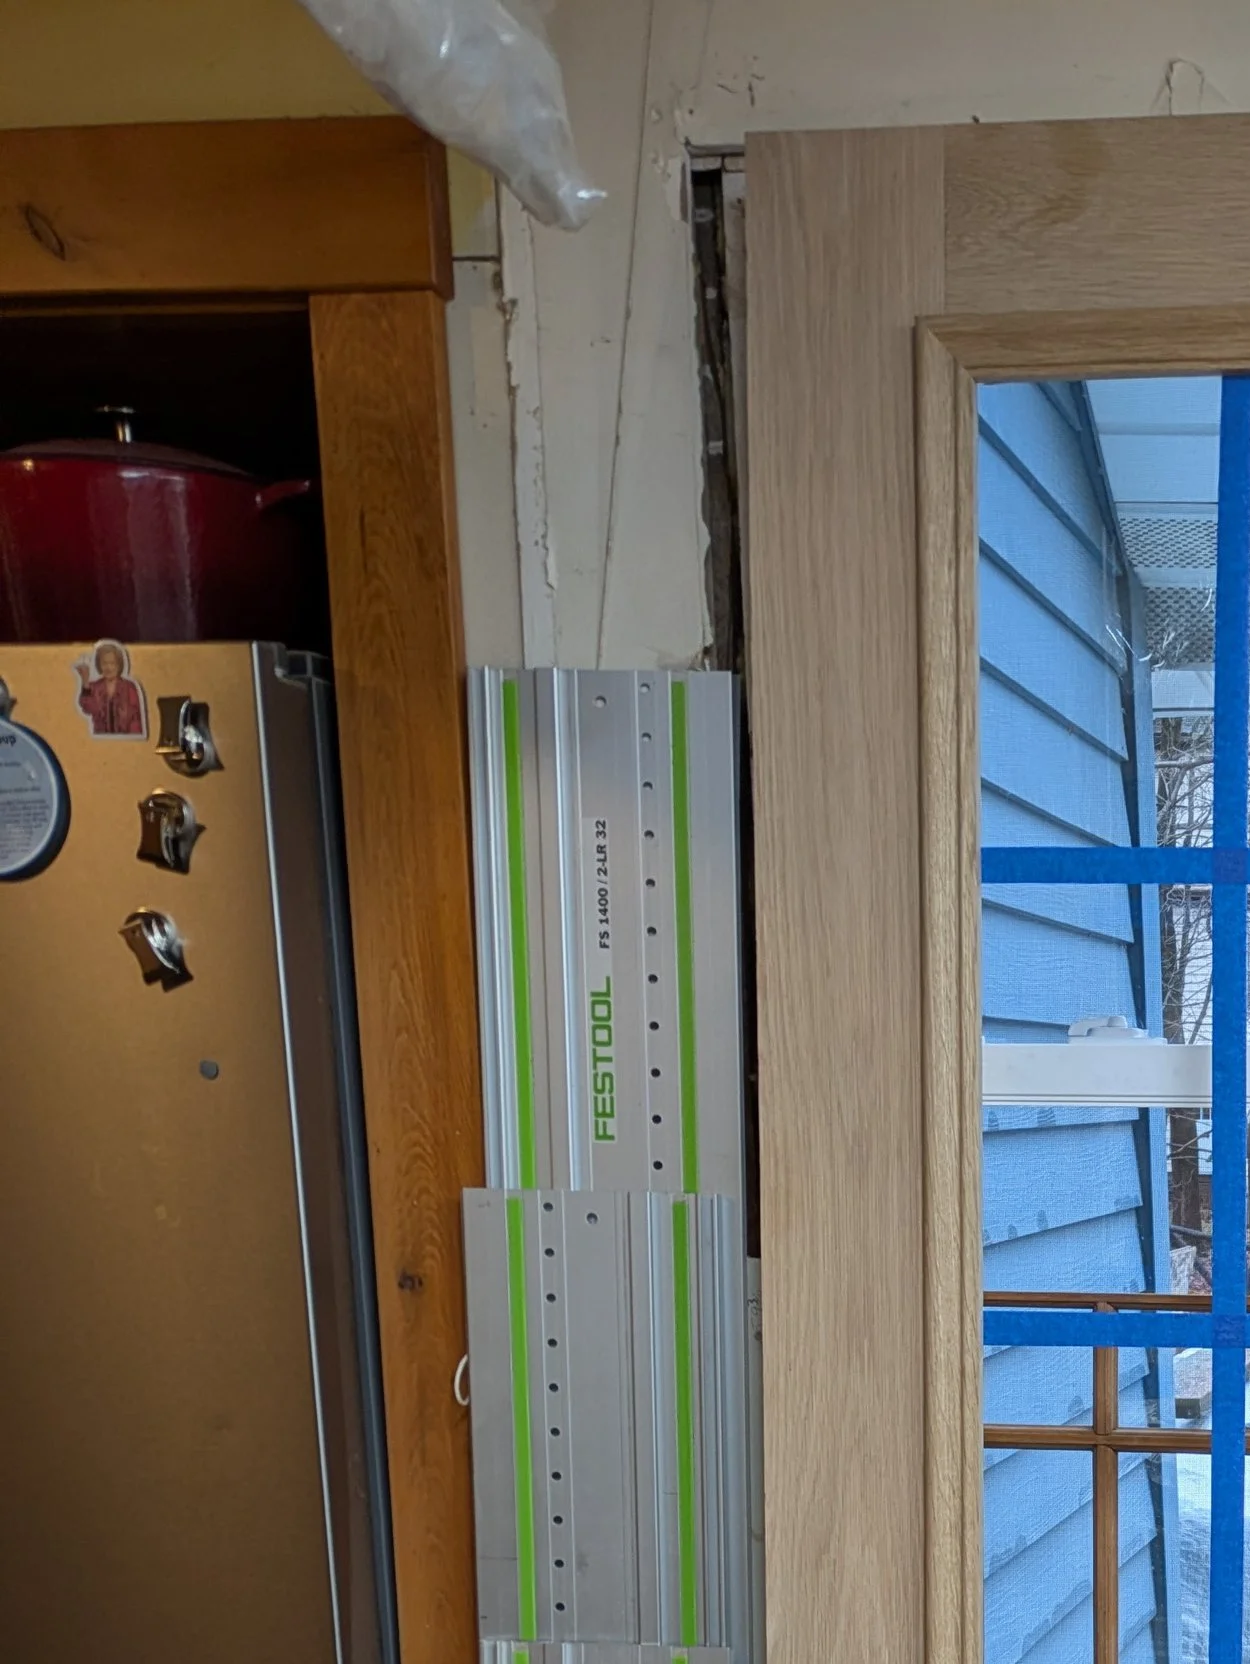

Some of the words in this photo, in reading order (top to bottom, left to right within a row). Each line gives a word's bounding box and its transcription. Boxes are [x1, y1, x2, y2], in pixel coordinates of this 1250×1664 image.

[595, 819, 607, 839] 32
[598, 929, 610, 950] FS
[589, 976, 616, 1141] FESTOOL
